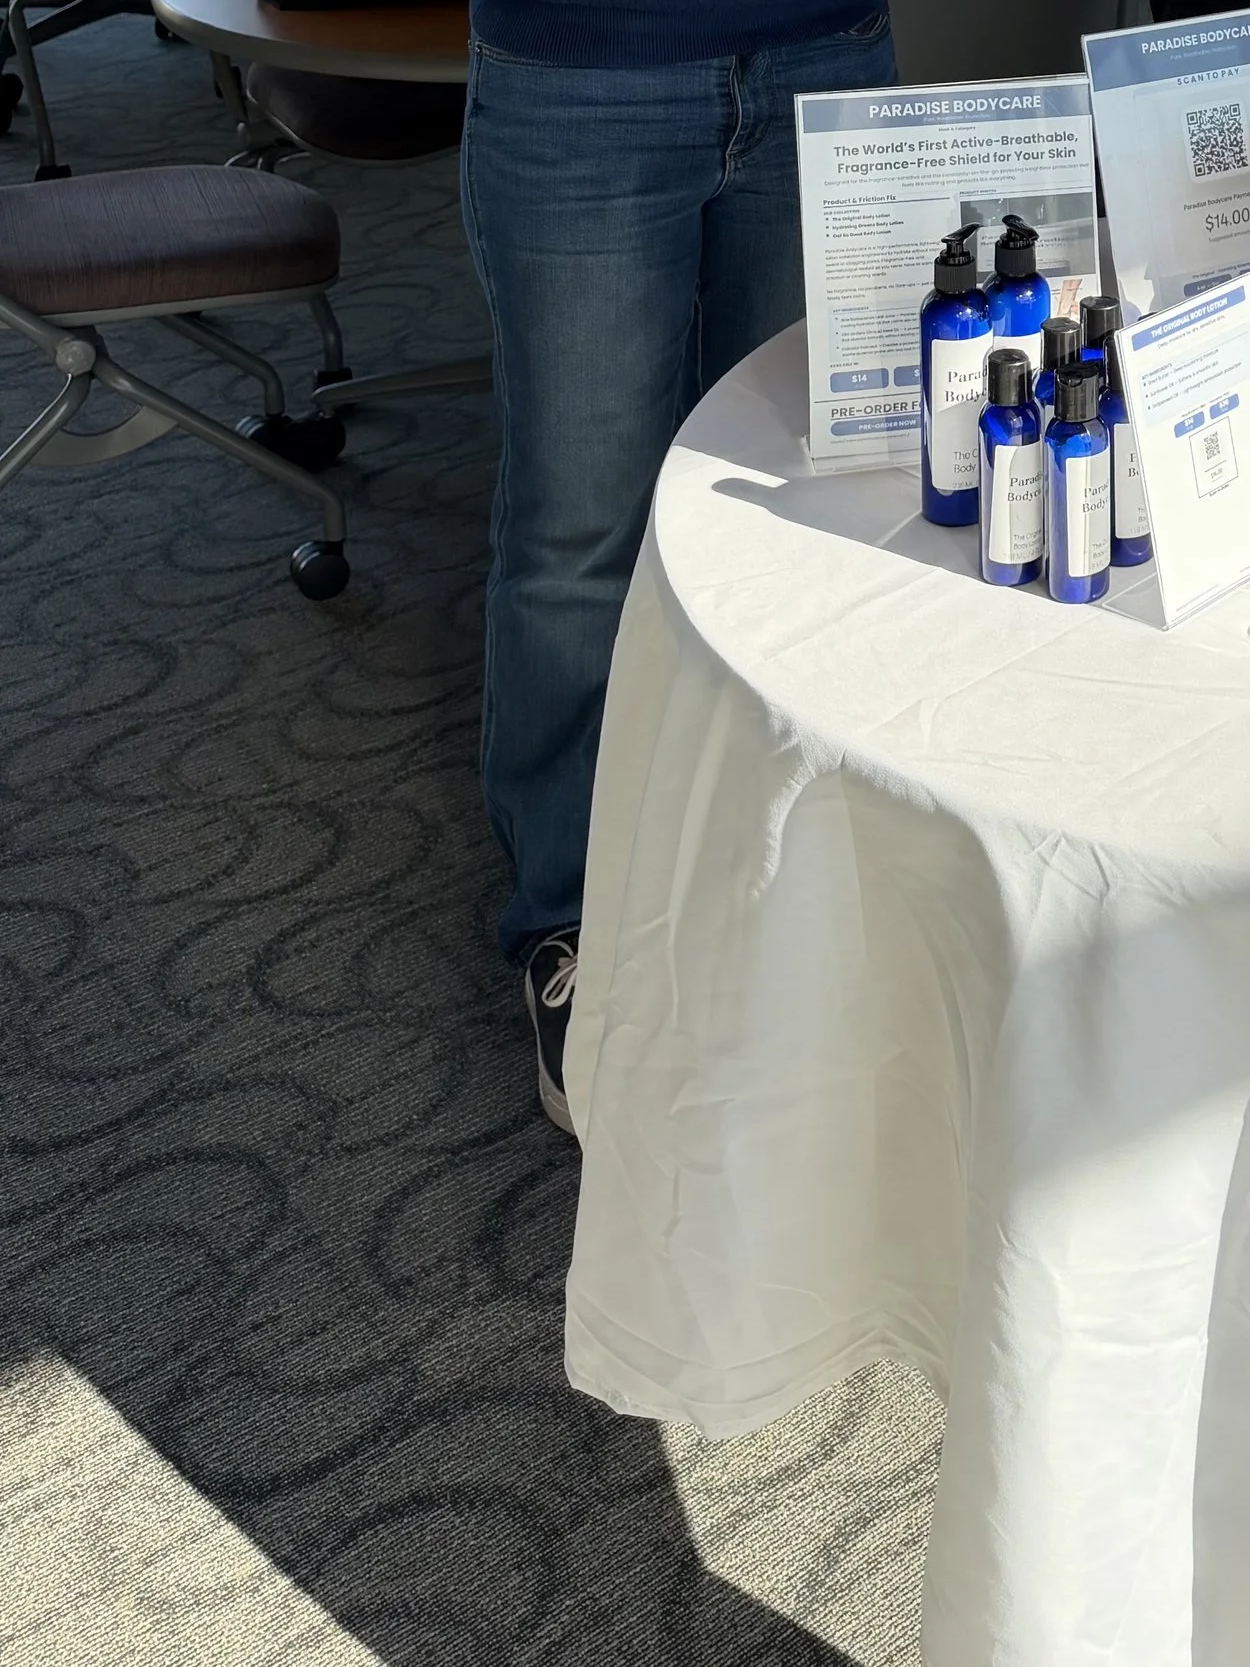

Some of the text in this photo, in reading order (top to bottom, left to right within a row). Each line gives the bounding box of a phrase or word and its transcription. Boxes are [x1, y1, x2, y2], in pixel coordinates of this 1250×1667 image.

[1141, 34, 1198, 54] PARADISE
[1177, 68, 1240, 85] SCAN TO PAY
[869, 100, 950, 118] PARADISE
[953, 95, 1041, 112] BODYCARE
[834, 131, 1078, 156] The World's First Active-Breathable,
[838, 146, 1076, 175] Fragrance-Free Shield for Your Skin
[823, 198, 852, 206] Product
[1184, 200, 1206, 210] Paradise
[1205, 207, 1250, 232] $14.00
[1163, 314, 1190, 333] ORIGINAL
[1190, 308, 1206, 321] BODY
[1206, 296, 1228, 313] LOTION
[852, 374, 868, 383] $14
[831, 402, 908, 418] PRE-ORDER
[858, 420, 917, 431] PRE-ORDER NOW
[954, 452, 970, 460] The
[954, 462, 976, 474] Body
[1010, 471, 1041, 487] Parad
[1082, 496, 1109, 512] Body
